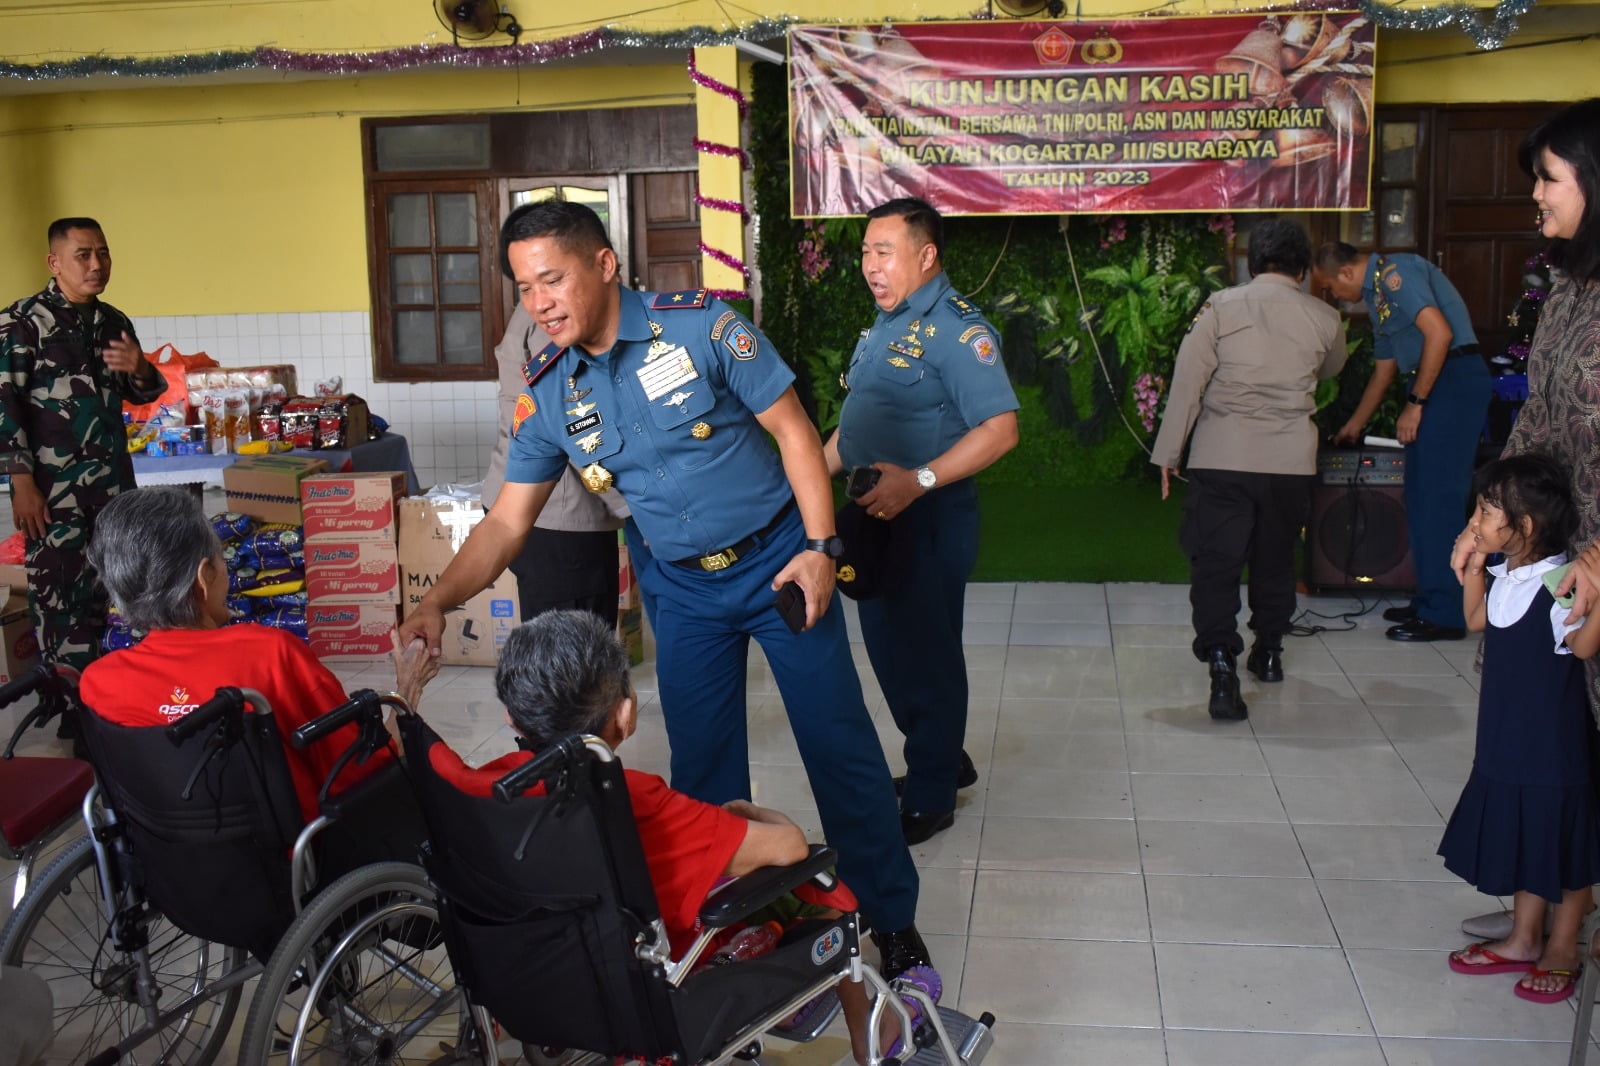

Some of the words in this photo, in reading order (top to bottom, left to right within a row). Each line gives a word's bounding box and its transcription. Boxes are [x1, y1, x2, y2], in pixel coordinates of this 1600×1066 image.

[910, 76, 1128, 106] KUNJUNGAN
[1140, 74, 1249, 102] KASIH
[903, 115, 954, 136] NATAL
[959, 114, 1037, 134] BERSAMA
[1042, 112, 1129, 135] TNI/POLRI,
[1133, 110, 1167, 131] ASN
[1172, 109, 1204, 130] DAN
[1211, 108, 1324, 130] MASYARAKAT
[880, 144, 982, 164] WILAYAH
[989, 142, 1116, 162] KOGARTAP
[1123, 139, 1279, 160] III/SURABAYA
[1003, 172, 1086, 187] TAHUN
[1093, 170, 1150, 186] 2023
[337, 519, 374, 529] goreng
[342, 582, 379, 591] goreng
[342, 643, 379, 652] goreng
